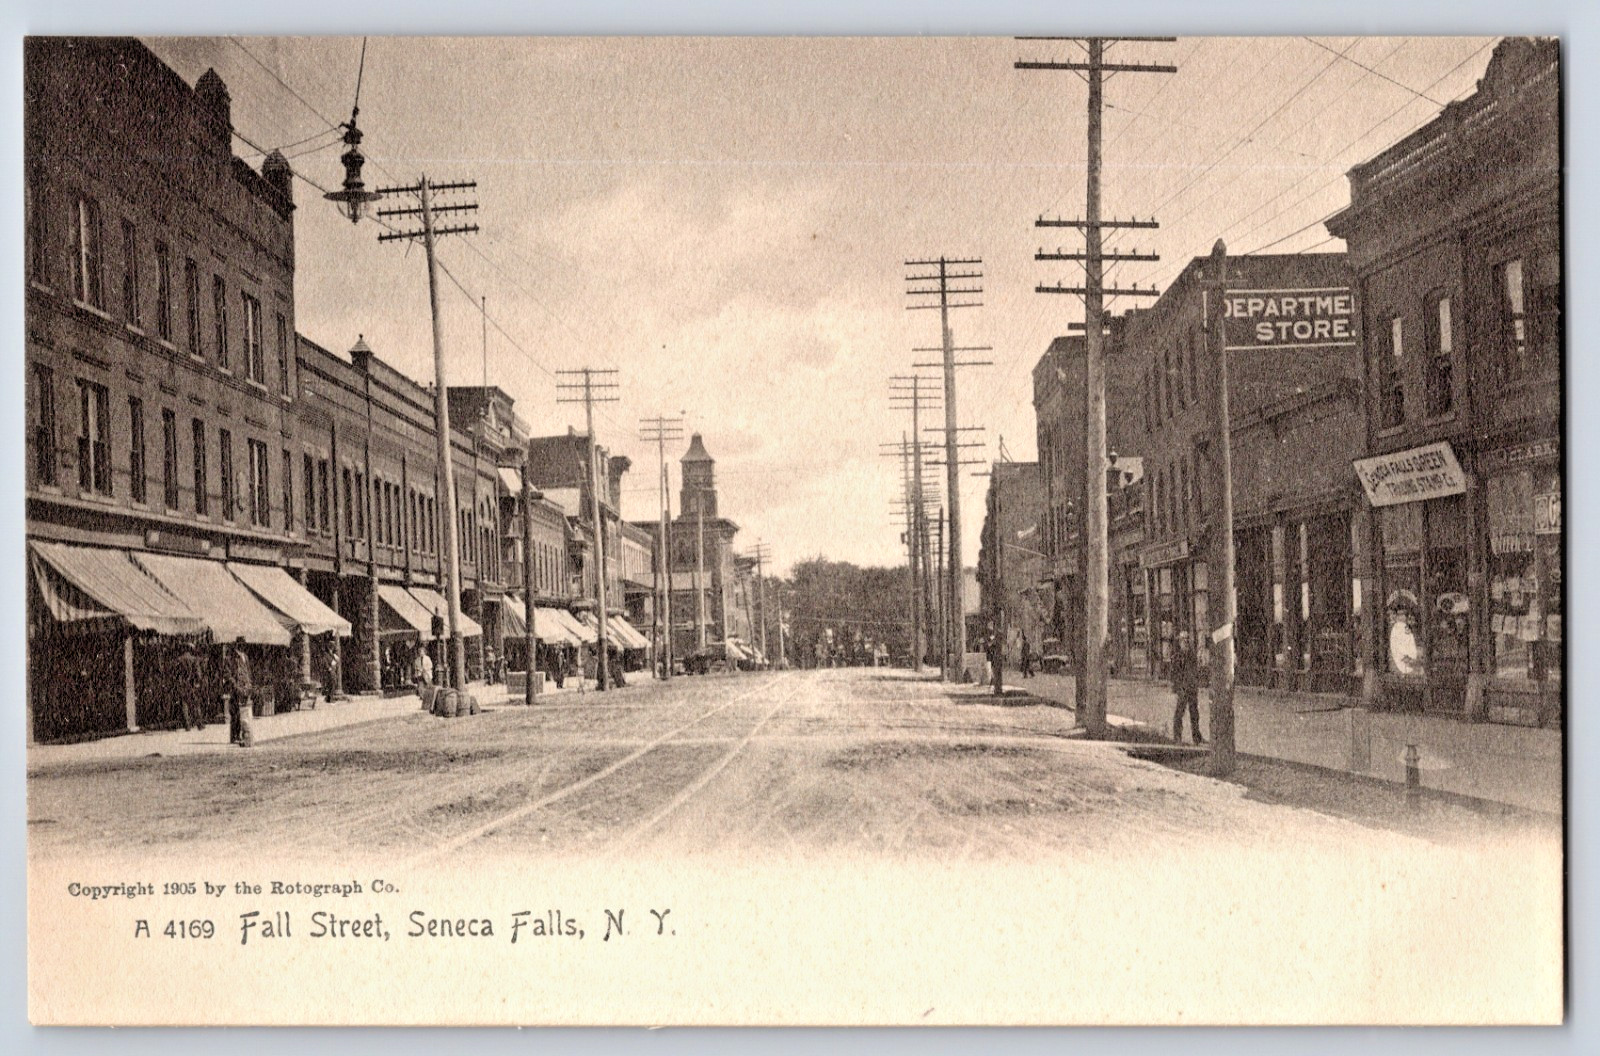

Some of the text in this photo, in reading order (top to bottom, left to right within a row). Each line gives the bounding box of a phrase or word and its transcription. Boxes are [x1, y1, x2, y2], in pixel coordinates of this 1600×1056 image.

[1224, 295, 1355, 318] DEPARTME
[1255, 319, 1356, 341] STORE.
[1413, 450, 1447, 472] GREEN
